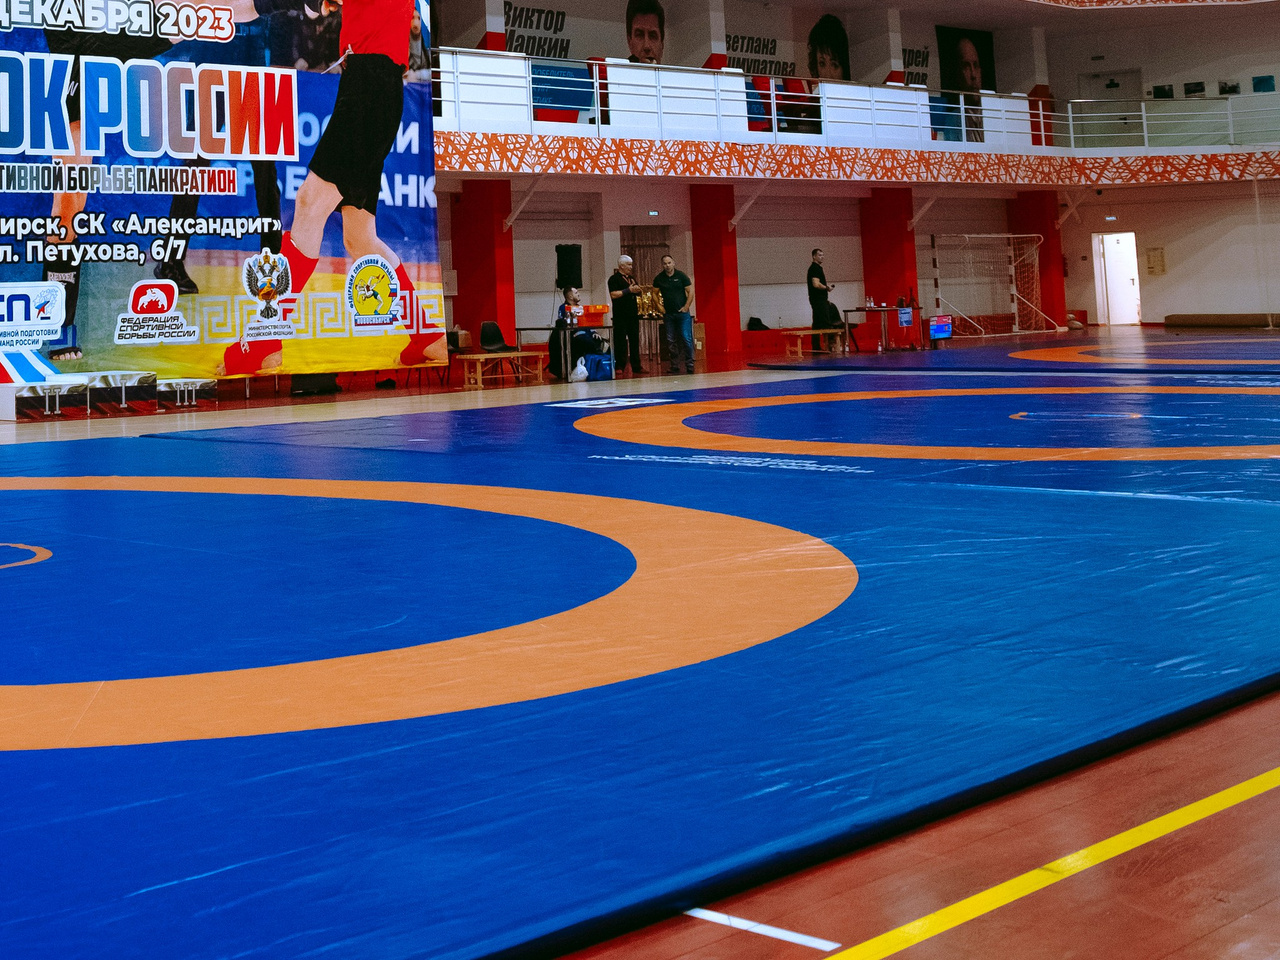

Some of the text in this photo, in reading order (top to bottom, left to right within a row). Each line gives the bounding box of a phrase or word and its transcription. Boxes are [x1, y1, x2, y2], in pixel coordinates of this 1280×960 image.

[156, 2, 235, 42] 2023
[503, 0, 566, 34] Виктор
[80, 56, 299, 161] РОССИИ
[66, 165, 134, 194] БОРЬБЕ
[135, 167, 238, 196] ПАНКРАТИОН
[73, 213, 106, 235] СК
[111, 214, 283, 241] «Александрит»
[26, 240, 146, 266] Петухова,
[150, 240, 187, 262] 6/7
[20, 328, 59, 338] ПОДГОТОВКИ
[119, 322, 184, 332] СПОРТИВНОЙ
[120, 315, 180, 325] ФЕДЕРАЦИЯ
[15, 338, 40, 346] РОССИИ
[117, 330, 196, 340] БОРЬБЫ РОССИИ
